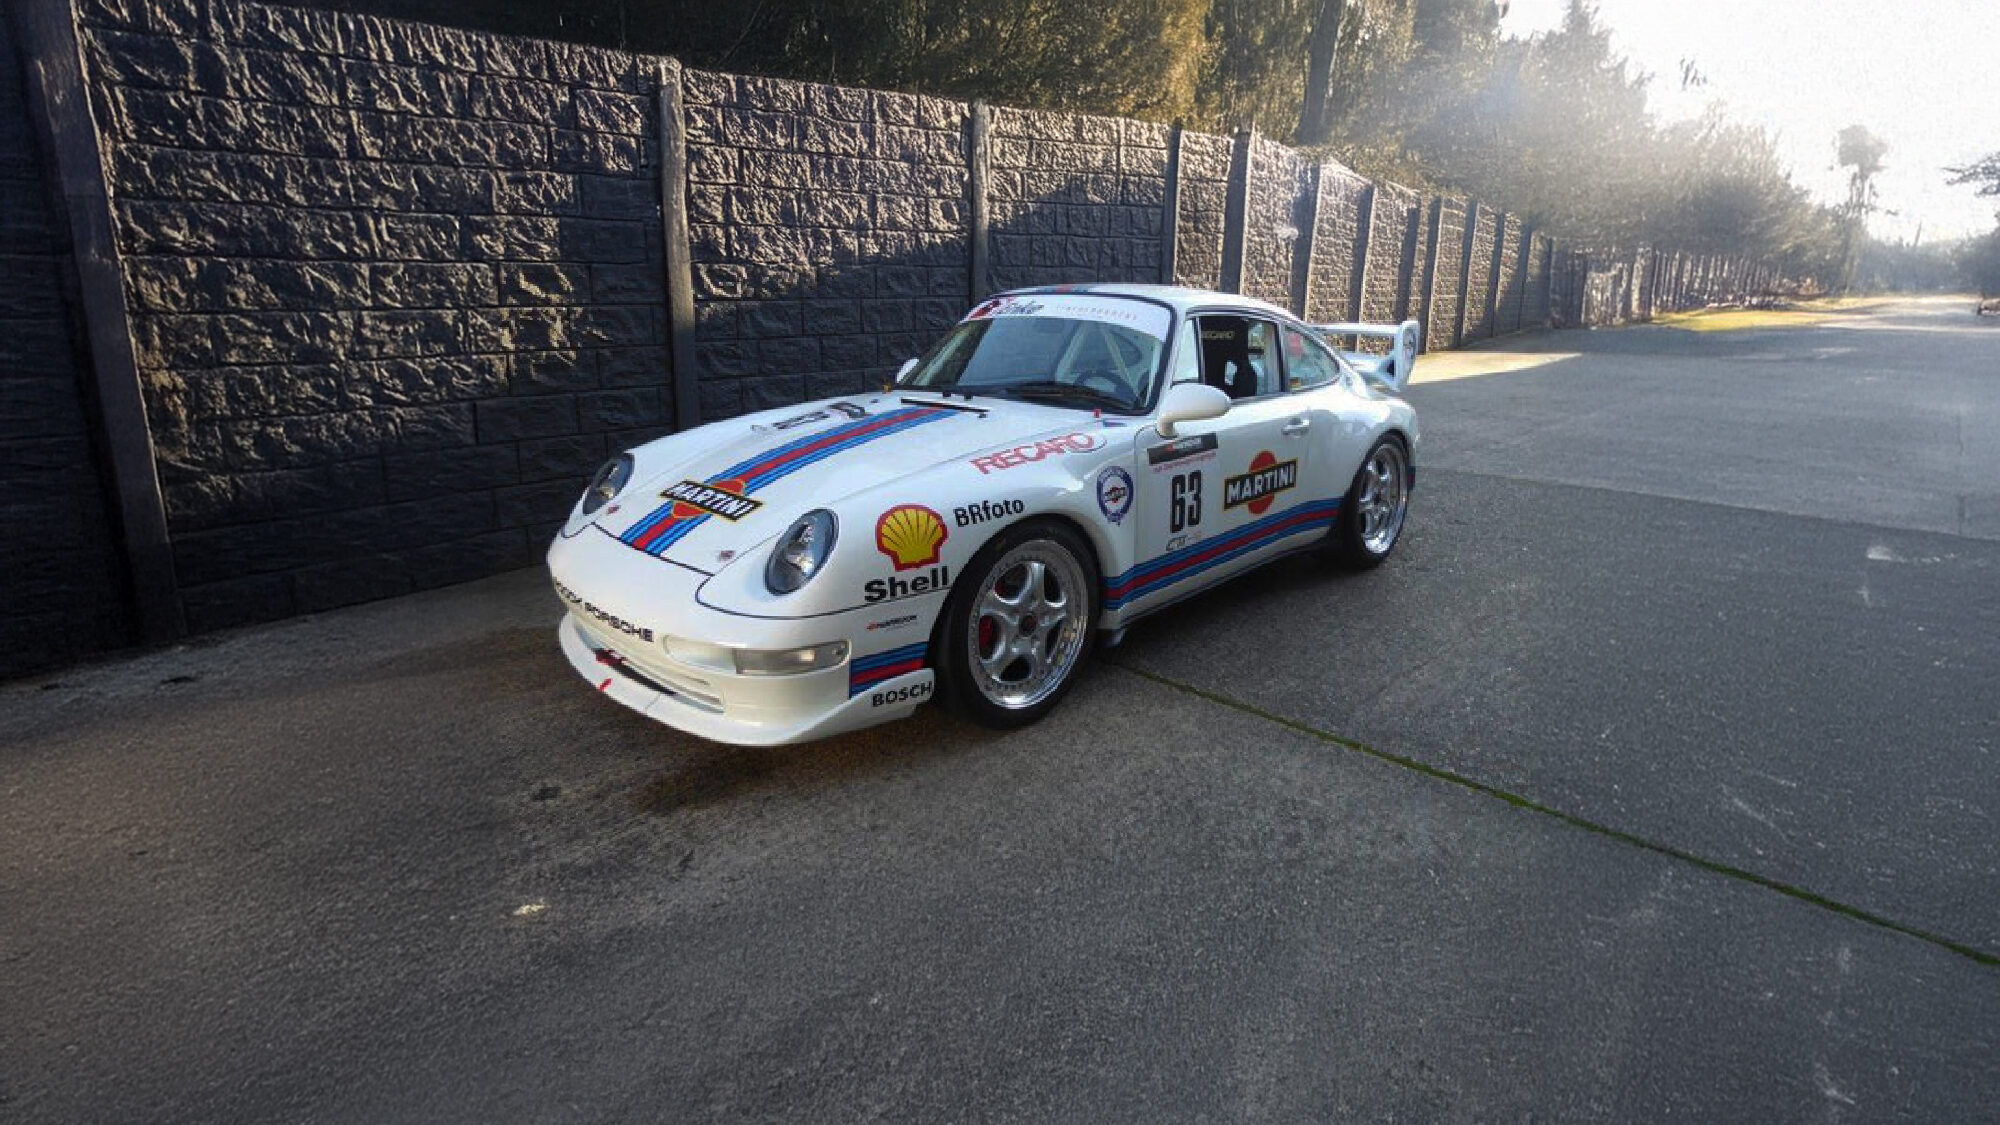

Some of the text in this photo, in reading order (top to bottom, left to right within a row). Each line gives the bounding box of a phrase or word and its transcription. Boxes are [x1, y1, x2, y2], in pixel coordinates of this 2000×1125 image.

[970, 433, 1094, 475] RECARO
[664, 482, 757, 518] MARTINI
[1170, 470, 1201, 534] 63
[1226, 463, 1296, 504] MARTINI
[953, 499, 1025, 527] BRfoto
[864, 566, 948, 602] Shell
[584, 601, 655, 643] PORSCHE
[872, 681, 932, 708] BOSCH
